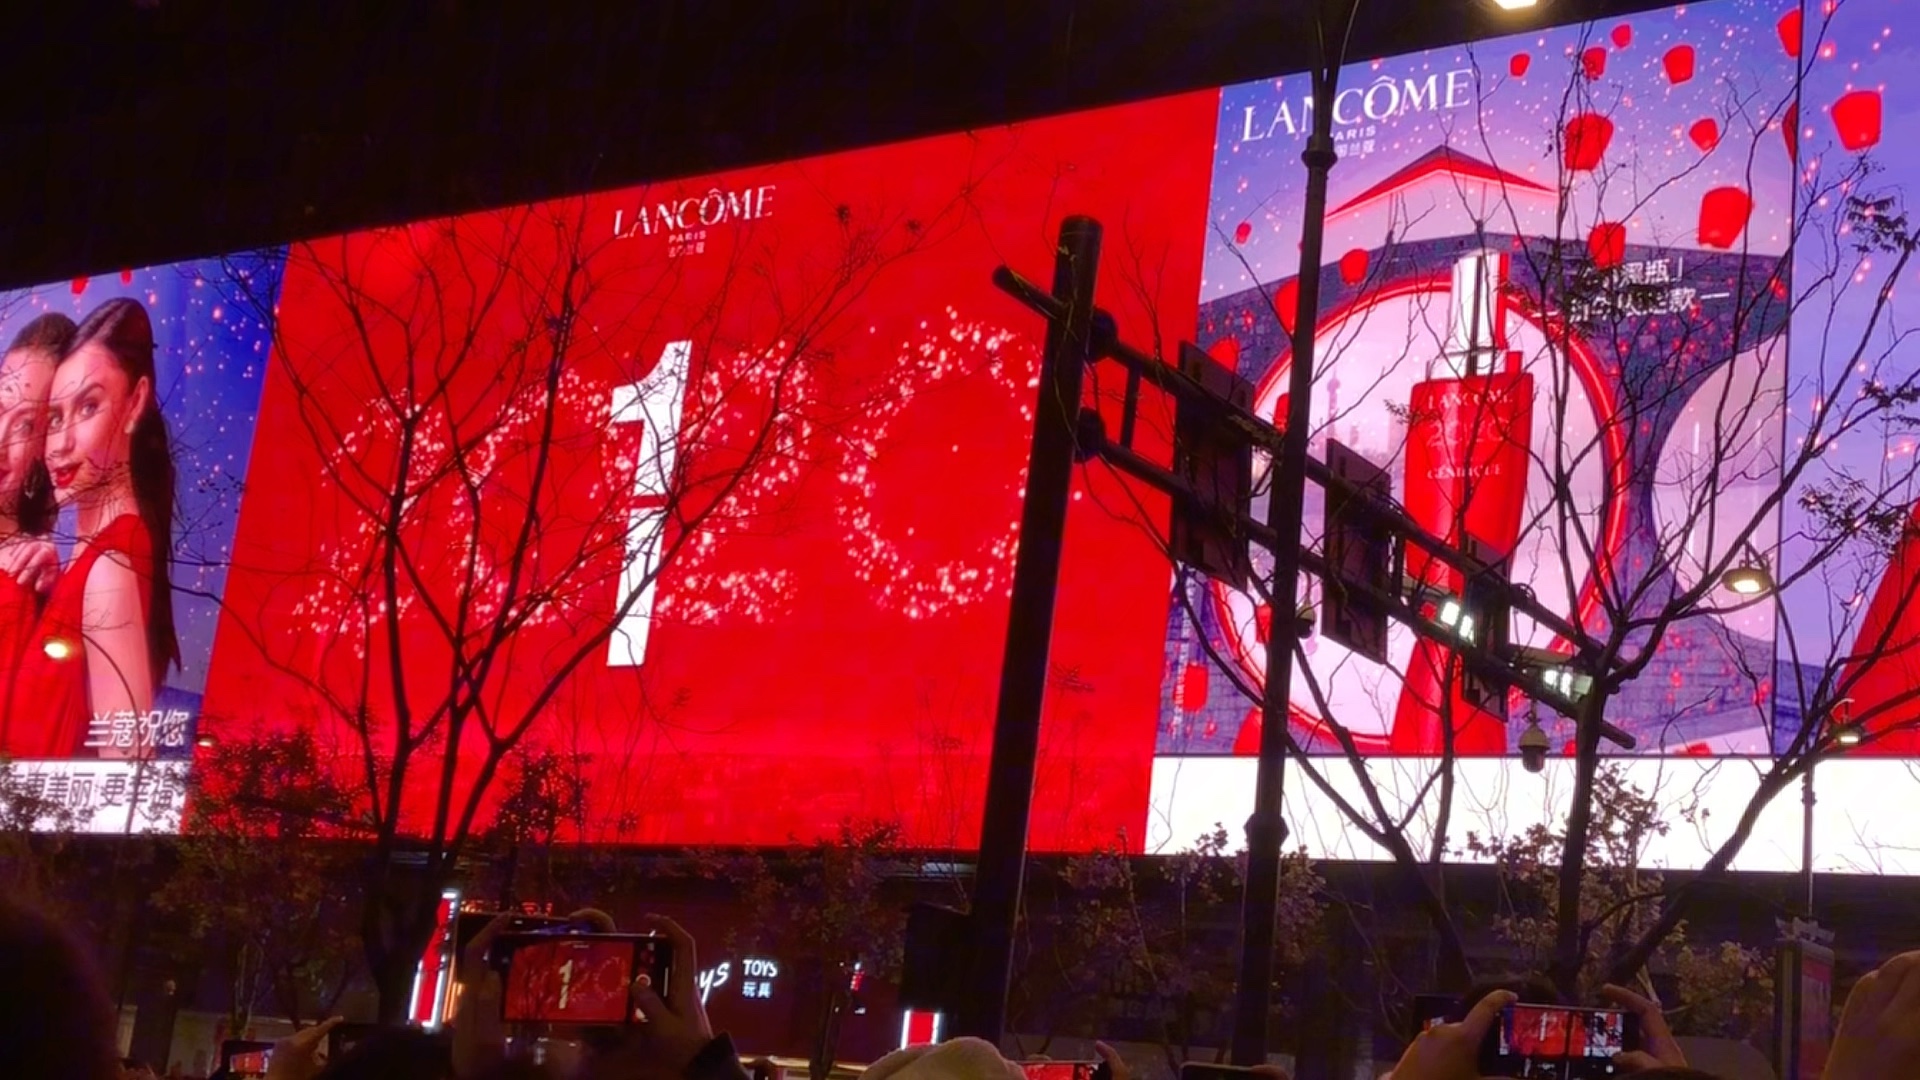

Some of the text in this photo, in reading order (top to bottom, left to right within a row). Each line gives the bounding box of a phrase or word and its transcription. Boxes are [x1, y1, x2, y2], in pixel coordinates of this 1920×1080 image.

[1330, 125, 1376, 141] ARIS
[613, 184, 776, 239] LANCÔME
[668, 230, 706, 244] PARIS
[83, 709, 190, 747] 兰蔻祝您
[742, 959, 778, 977] TOYS
[741, 981, 772, 998] 玩具
